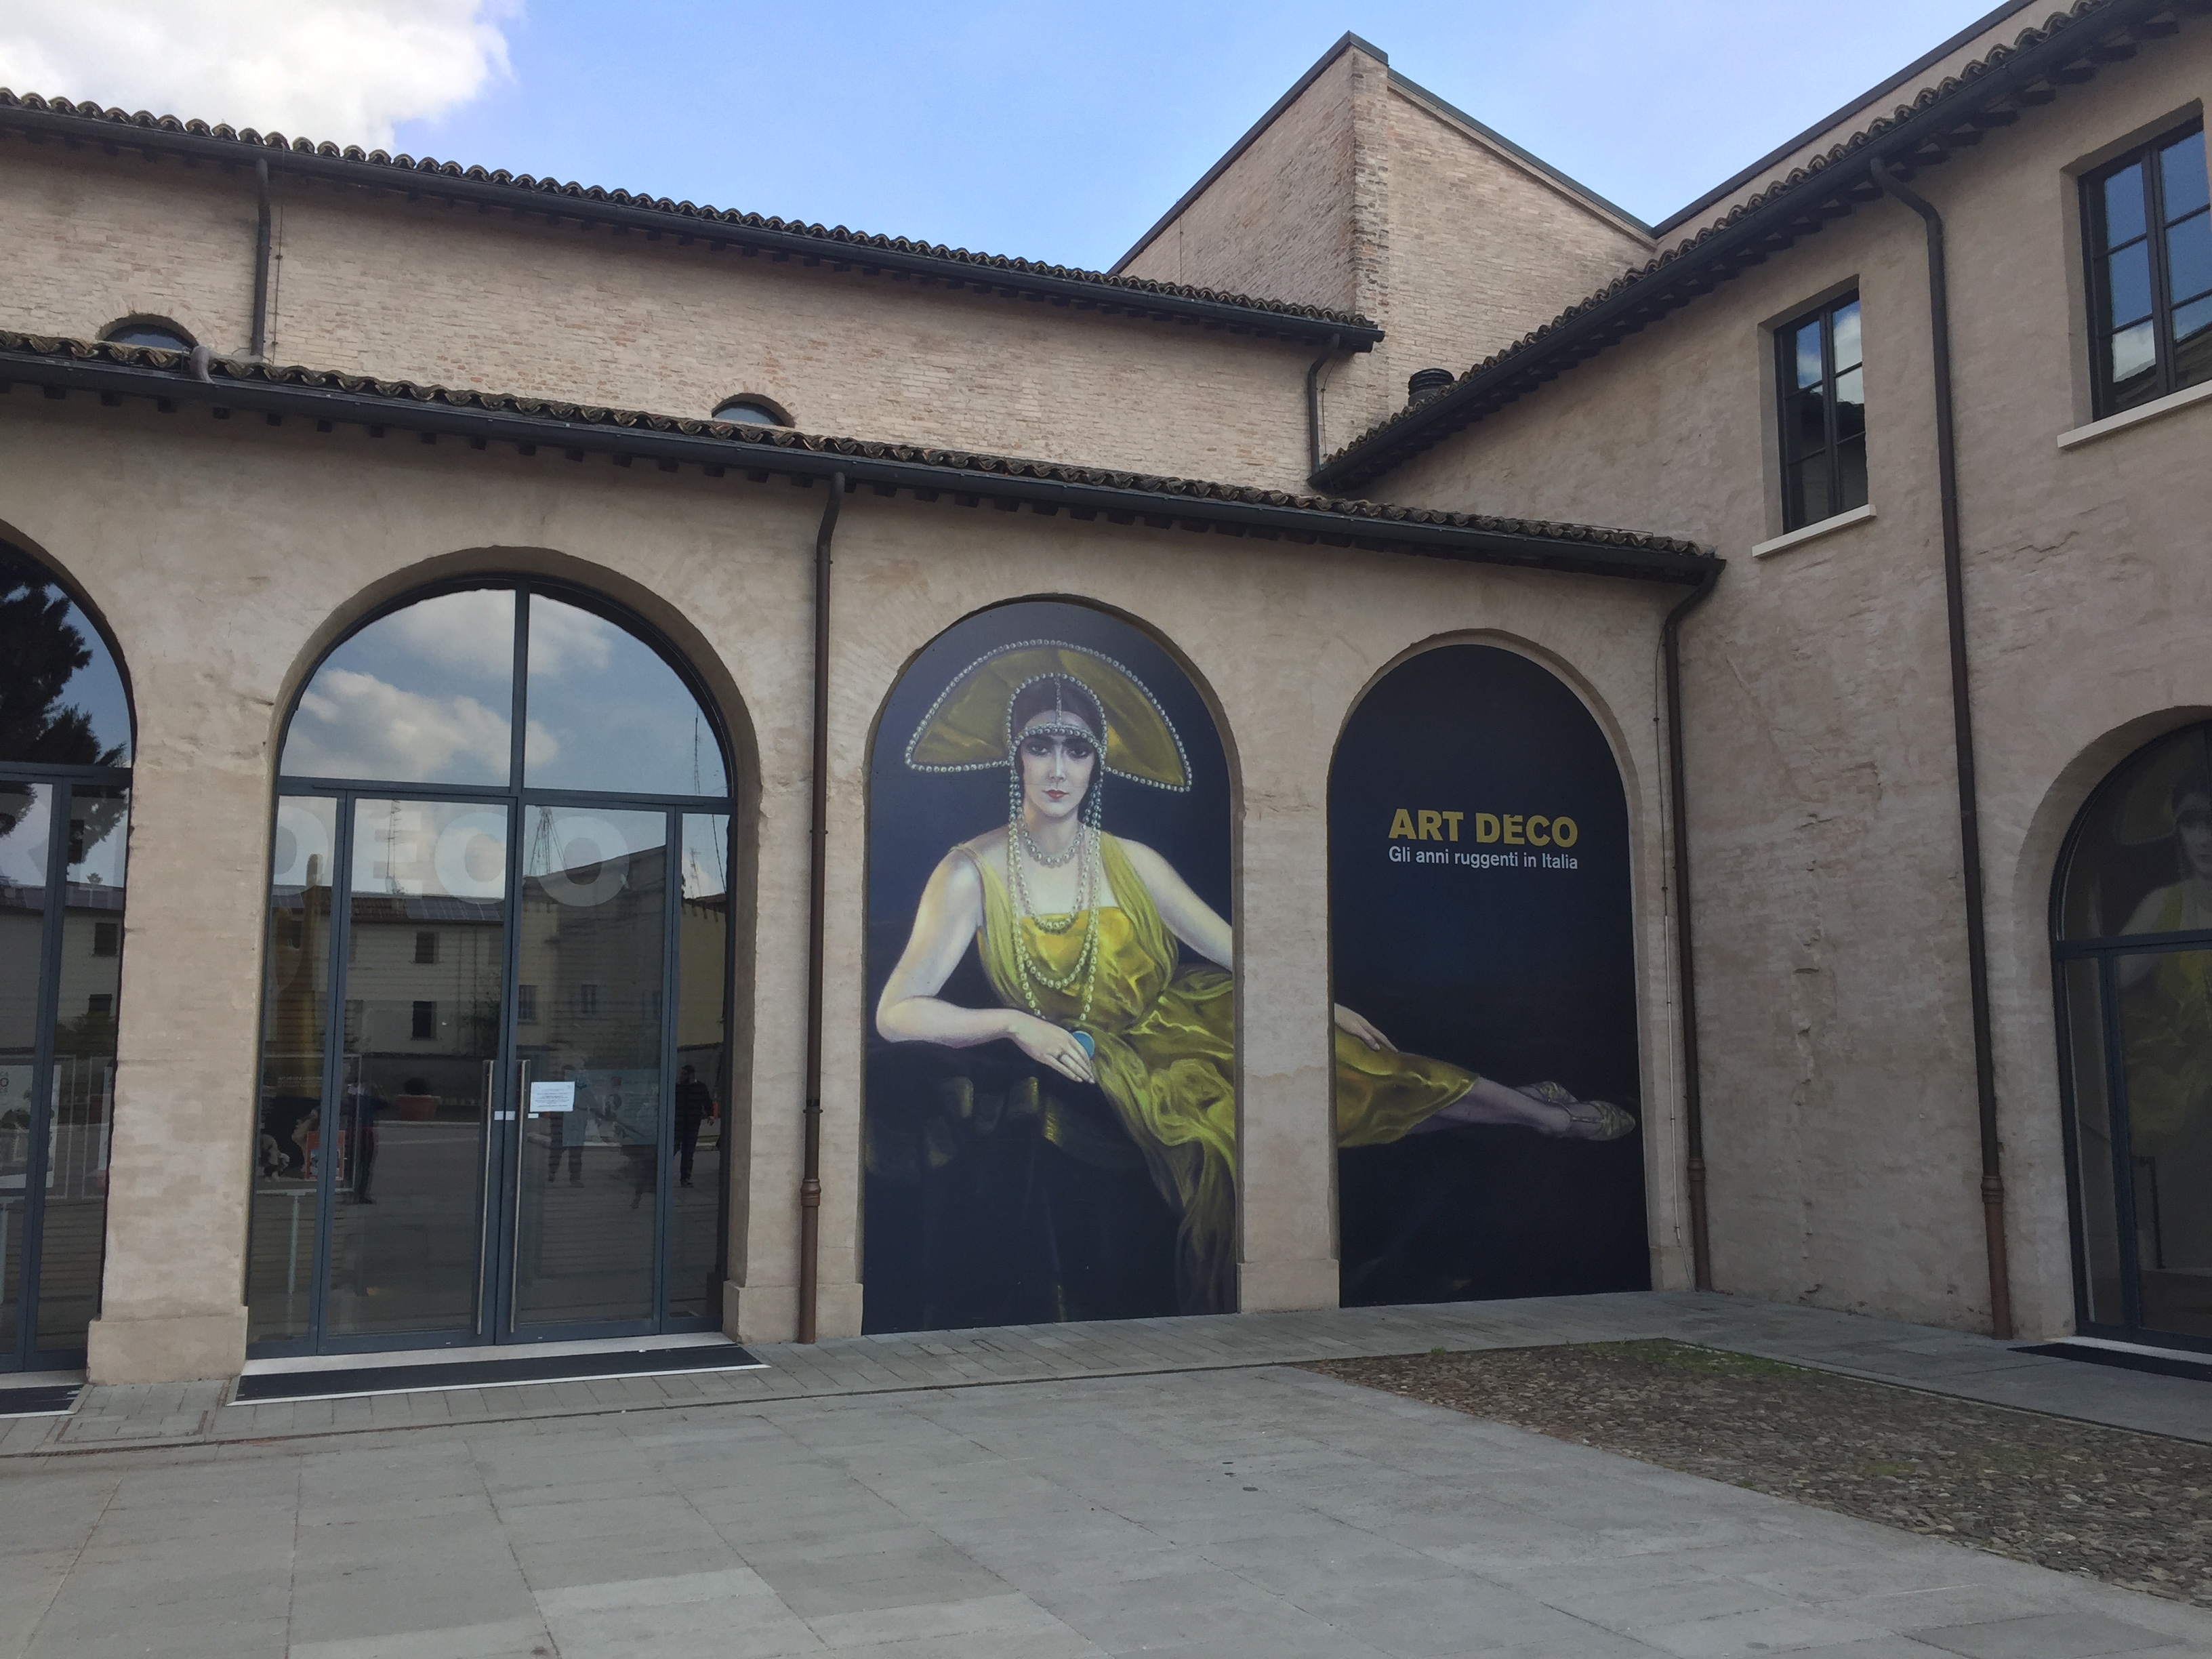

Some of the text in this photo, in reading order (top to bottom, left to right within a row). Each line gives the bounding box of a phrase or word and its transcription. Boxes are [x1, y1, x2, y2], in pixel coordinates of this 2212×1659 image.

[1389, 808, 1464, 842] ART
[1389, 846, 1578, 869] Gli anni ruggenti in Italia
